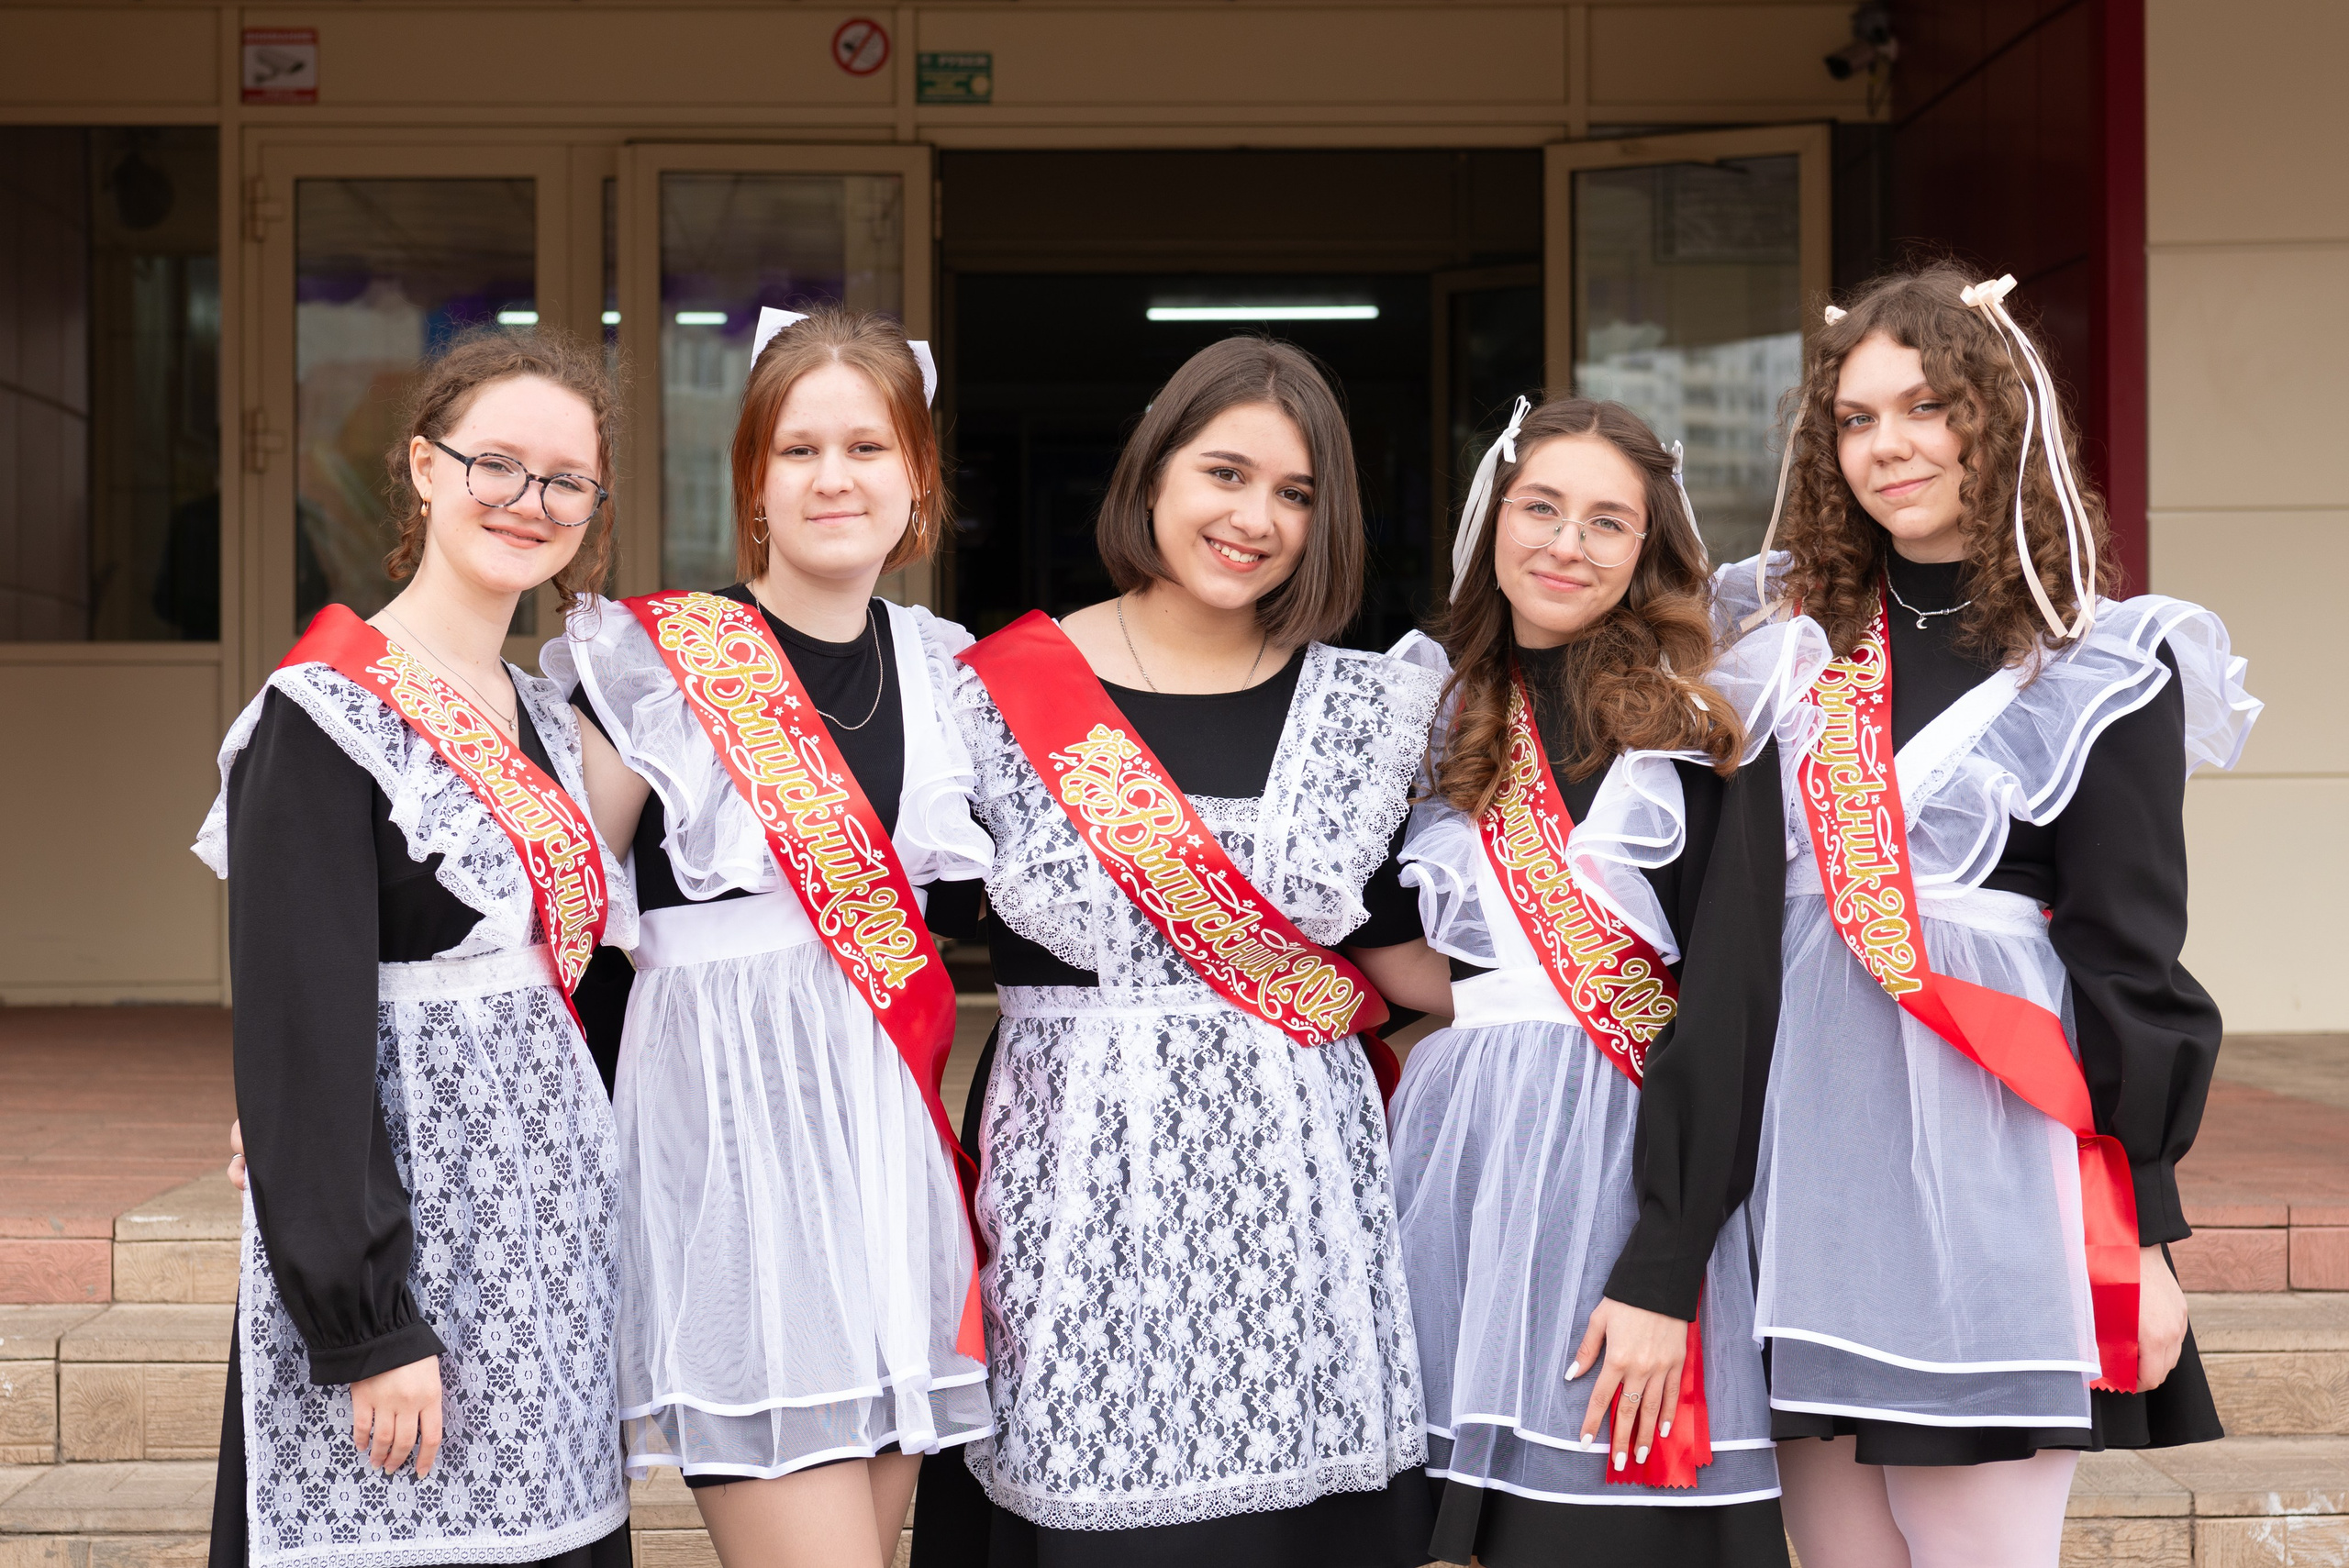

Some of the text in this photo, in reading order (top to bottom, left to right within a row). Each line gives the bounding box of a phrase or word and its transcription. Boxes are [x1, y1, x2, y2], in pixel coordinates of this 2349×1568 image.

[420, 694, 601, 988] Выпускник
[677, 626, 929, 990] Выпускник 2024
[1080, 773, 1365, 1041] Выпускник 2024
[1490, 729, 1678, 1043] Выпускник 202
[1809, 629, 1923, 1002] Выпускник 2024
